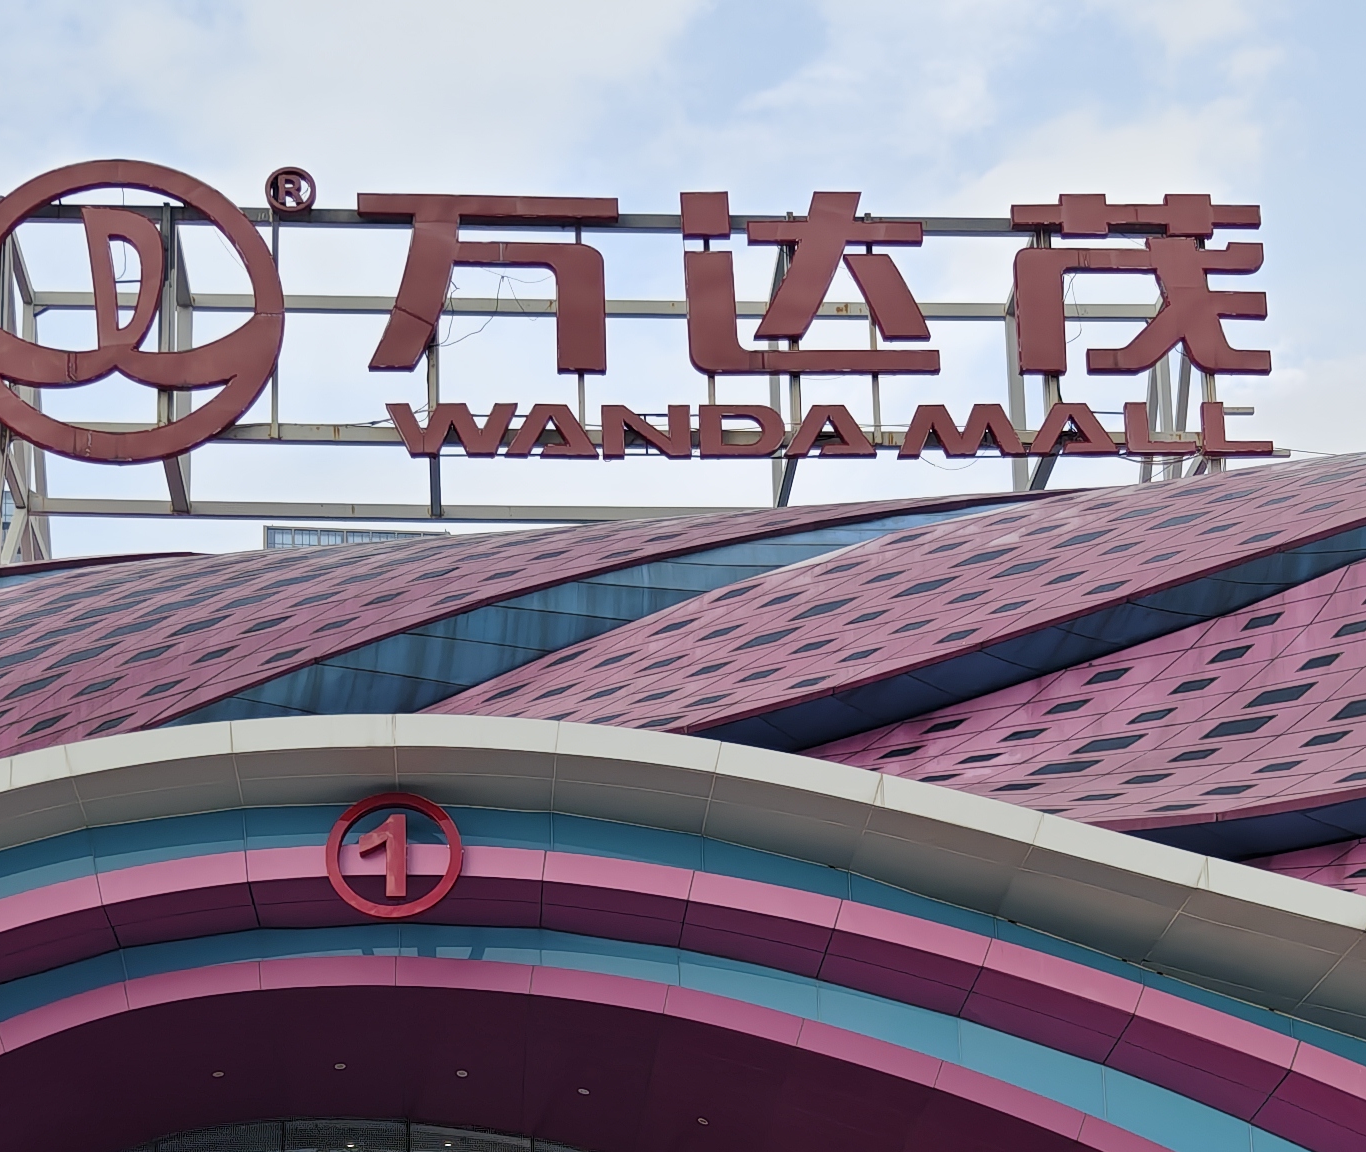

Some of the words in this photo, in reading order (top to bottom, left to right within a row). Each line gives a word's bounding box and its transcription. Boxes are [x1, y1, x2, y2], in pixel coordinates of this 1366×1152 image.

[356, 190, 1272, 376] 万达茂
[386, 402, 876, 460] WANDA
[898, 400, 1275, 458] MALL
